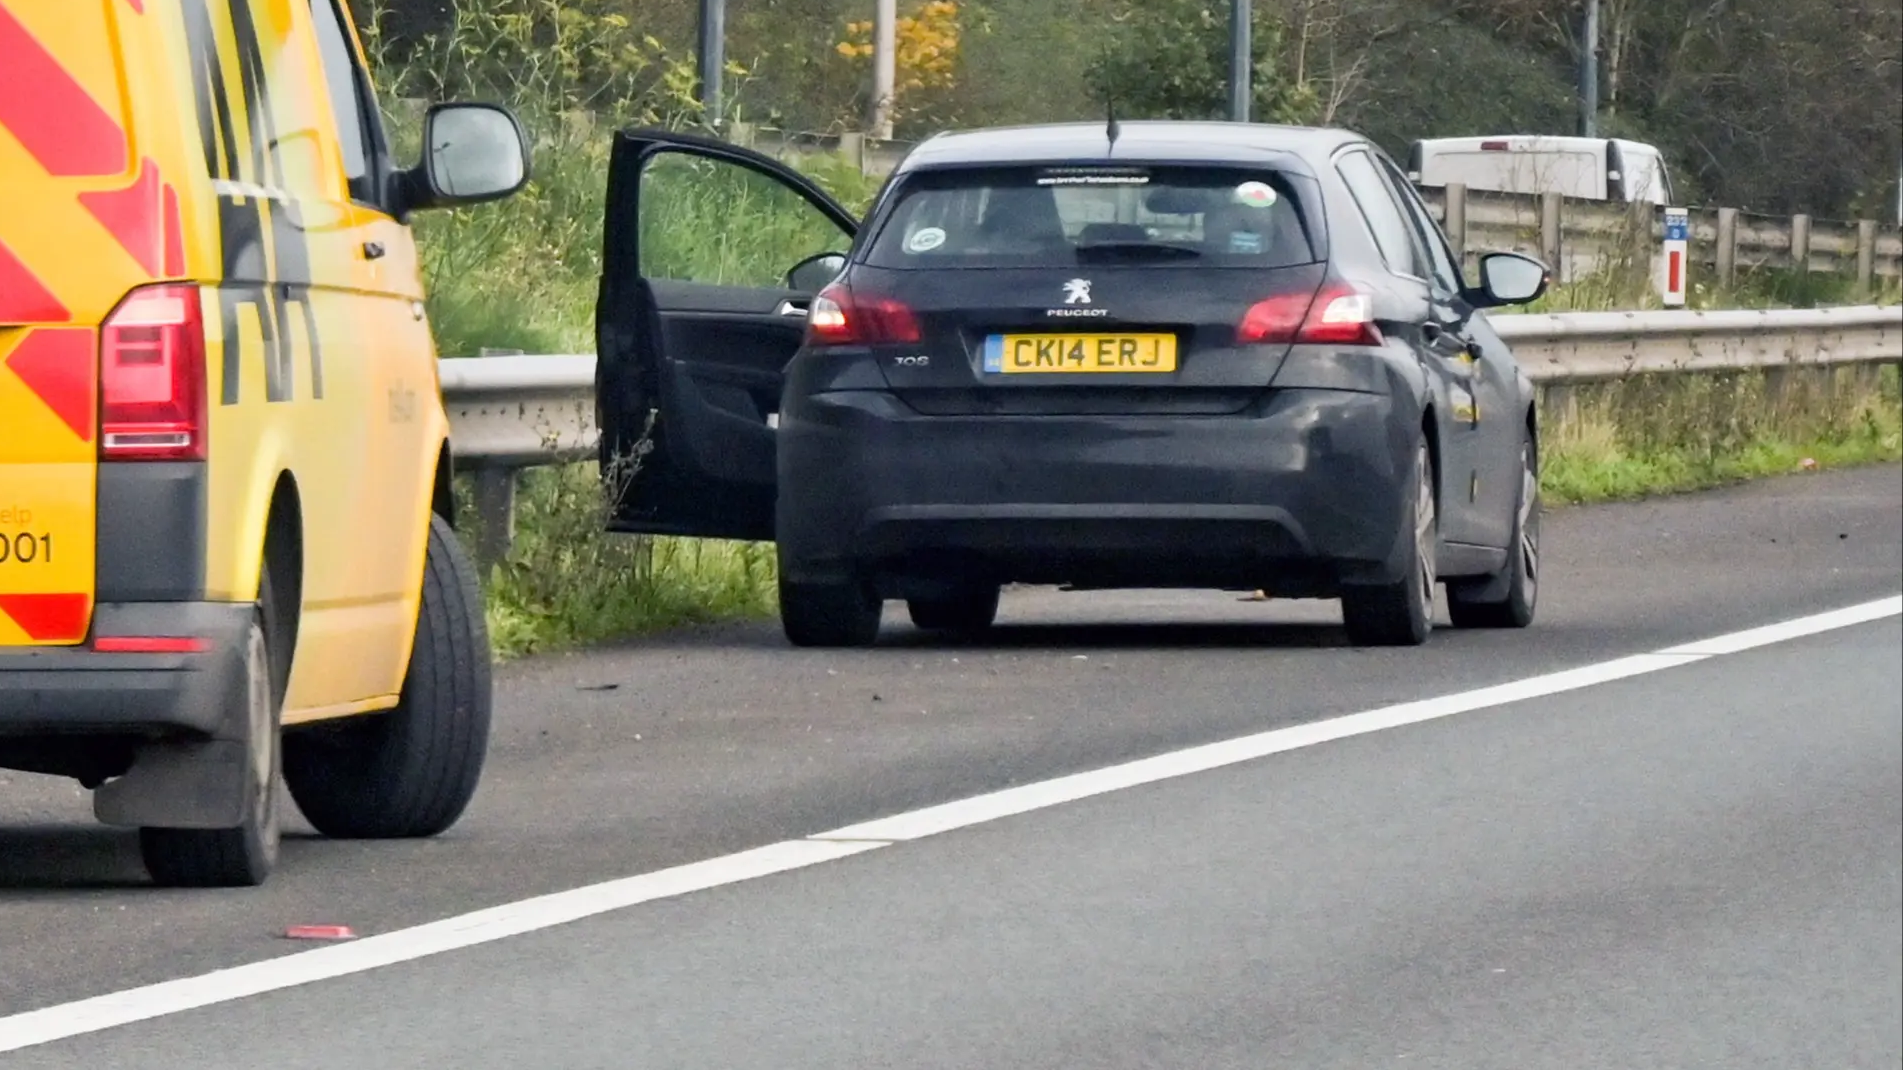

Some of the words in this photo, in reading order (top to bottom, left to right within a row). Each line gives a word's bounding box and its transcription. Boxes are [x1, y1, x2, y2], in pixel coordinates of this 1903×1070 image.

[1046, 308, 1108, 318] PEUGEOT
[1014, 338, 1086, 368] CK14
[1097, 337, 1161, 367] ERJ
